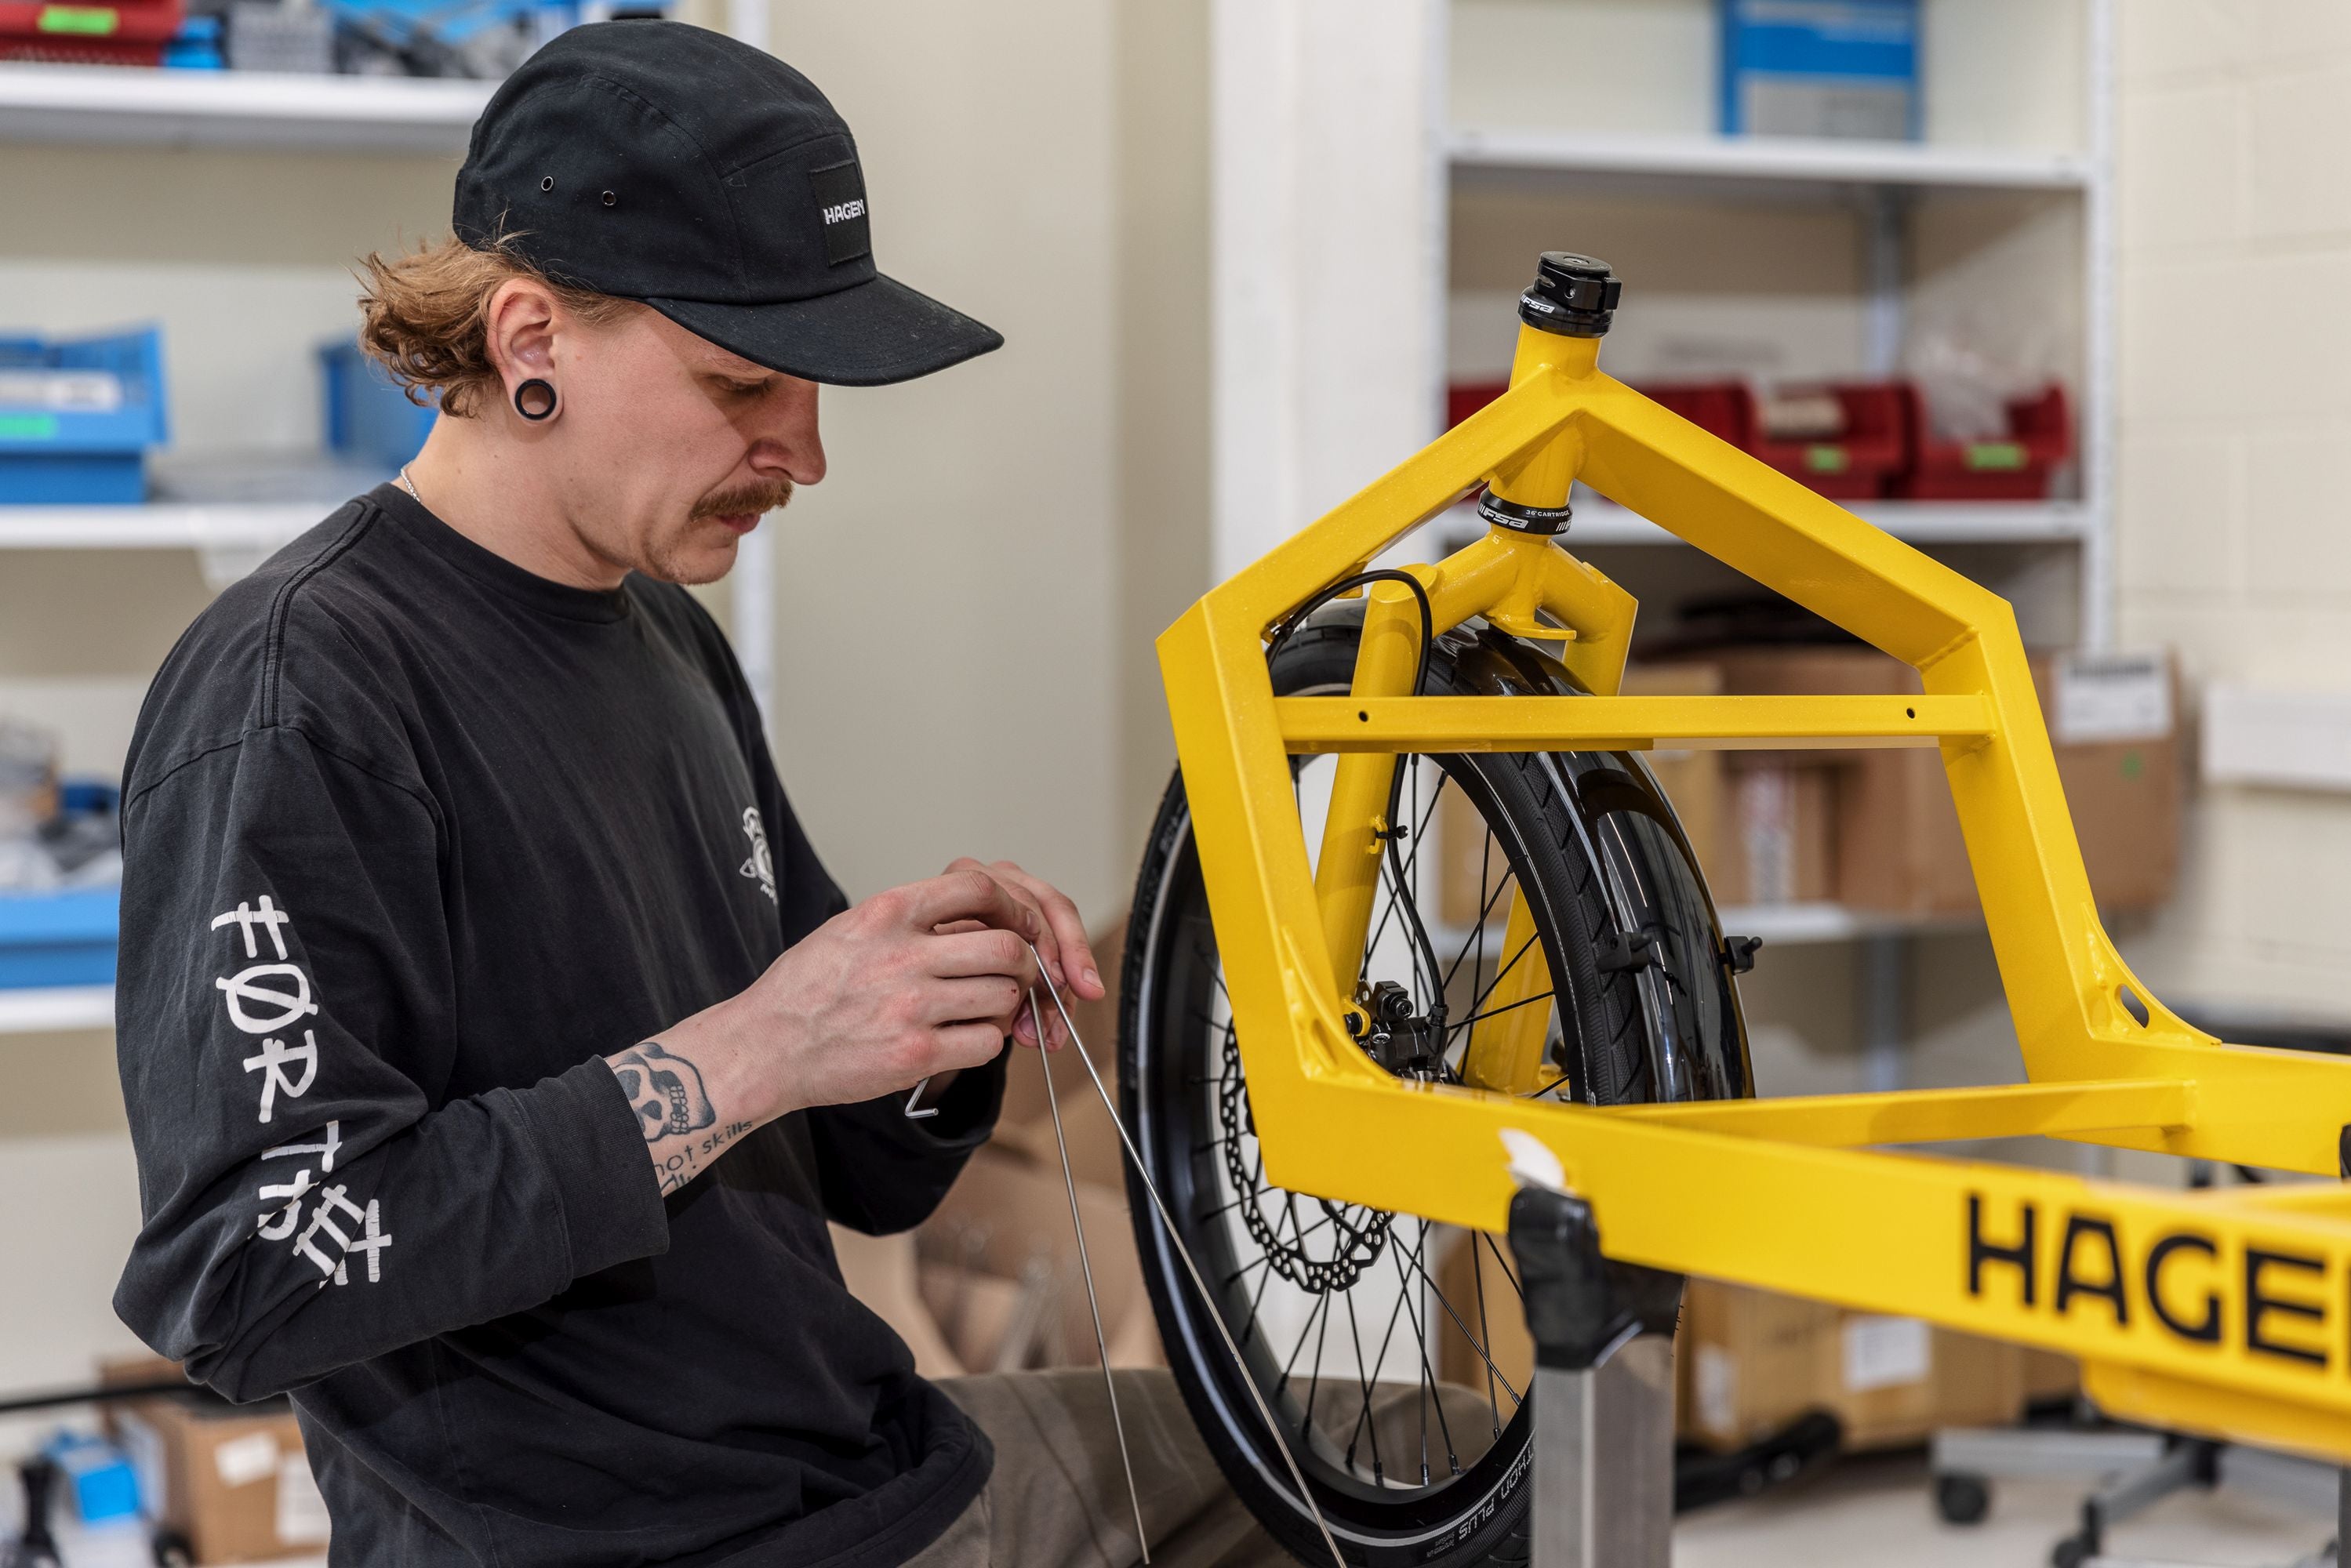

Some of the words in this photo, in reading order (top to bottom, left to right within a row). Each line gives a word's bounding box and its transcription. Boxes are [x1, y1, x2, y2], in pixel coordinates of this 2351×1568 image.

[823, 198, 866, 225] HAGEN
[1537, 509, 1570, 517] CARTRIDGE
[654, 1145, 693, 1176] not
[702, 1120, 753, 1155] skills
[1969, 1192, 2351, 1367] HAGE
[1458, 1497, 1495, 1541] PLUS
